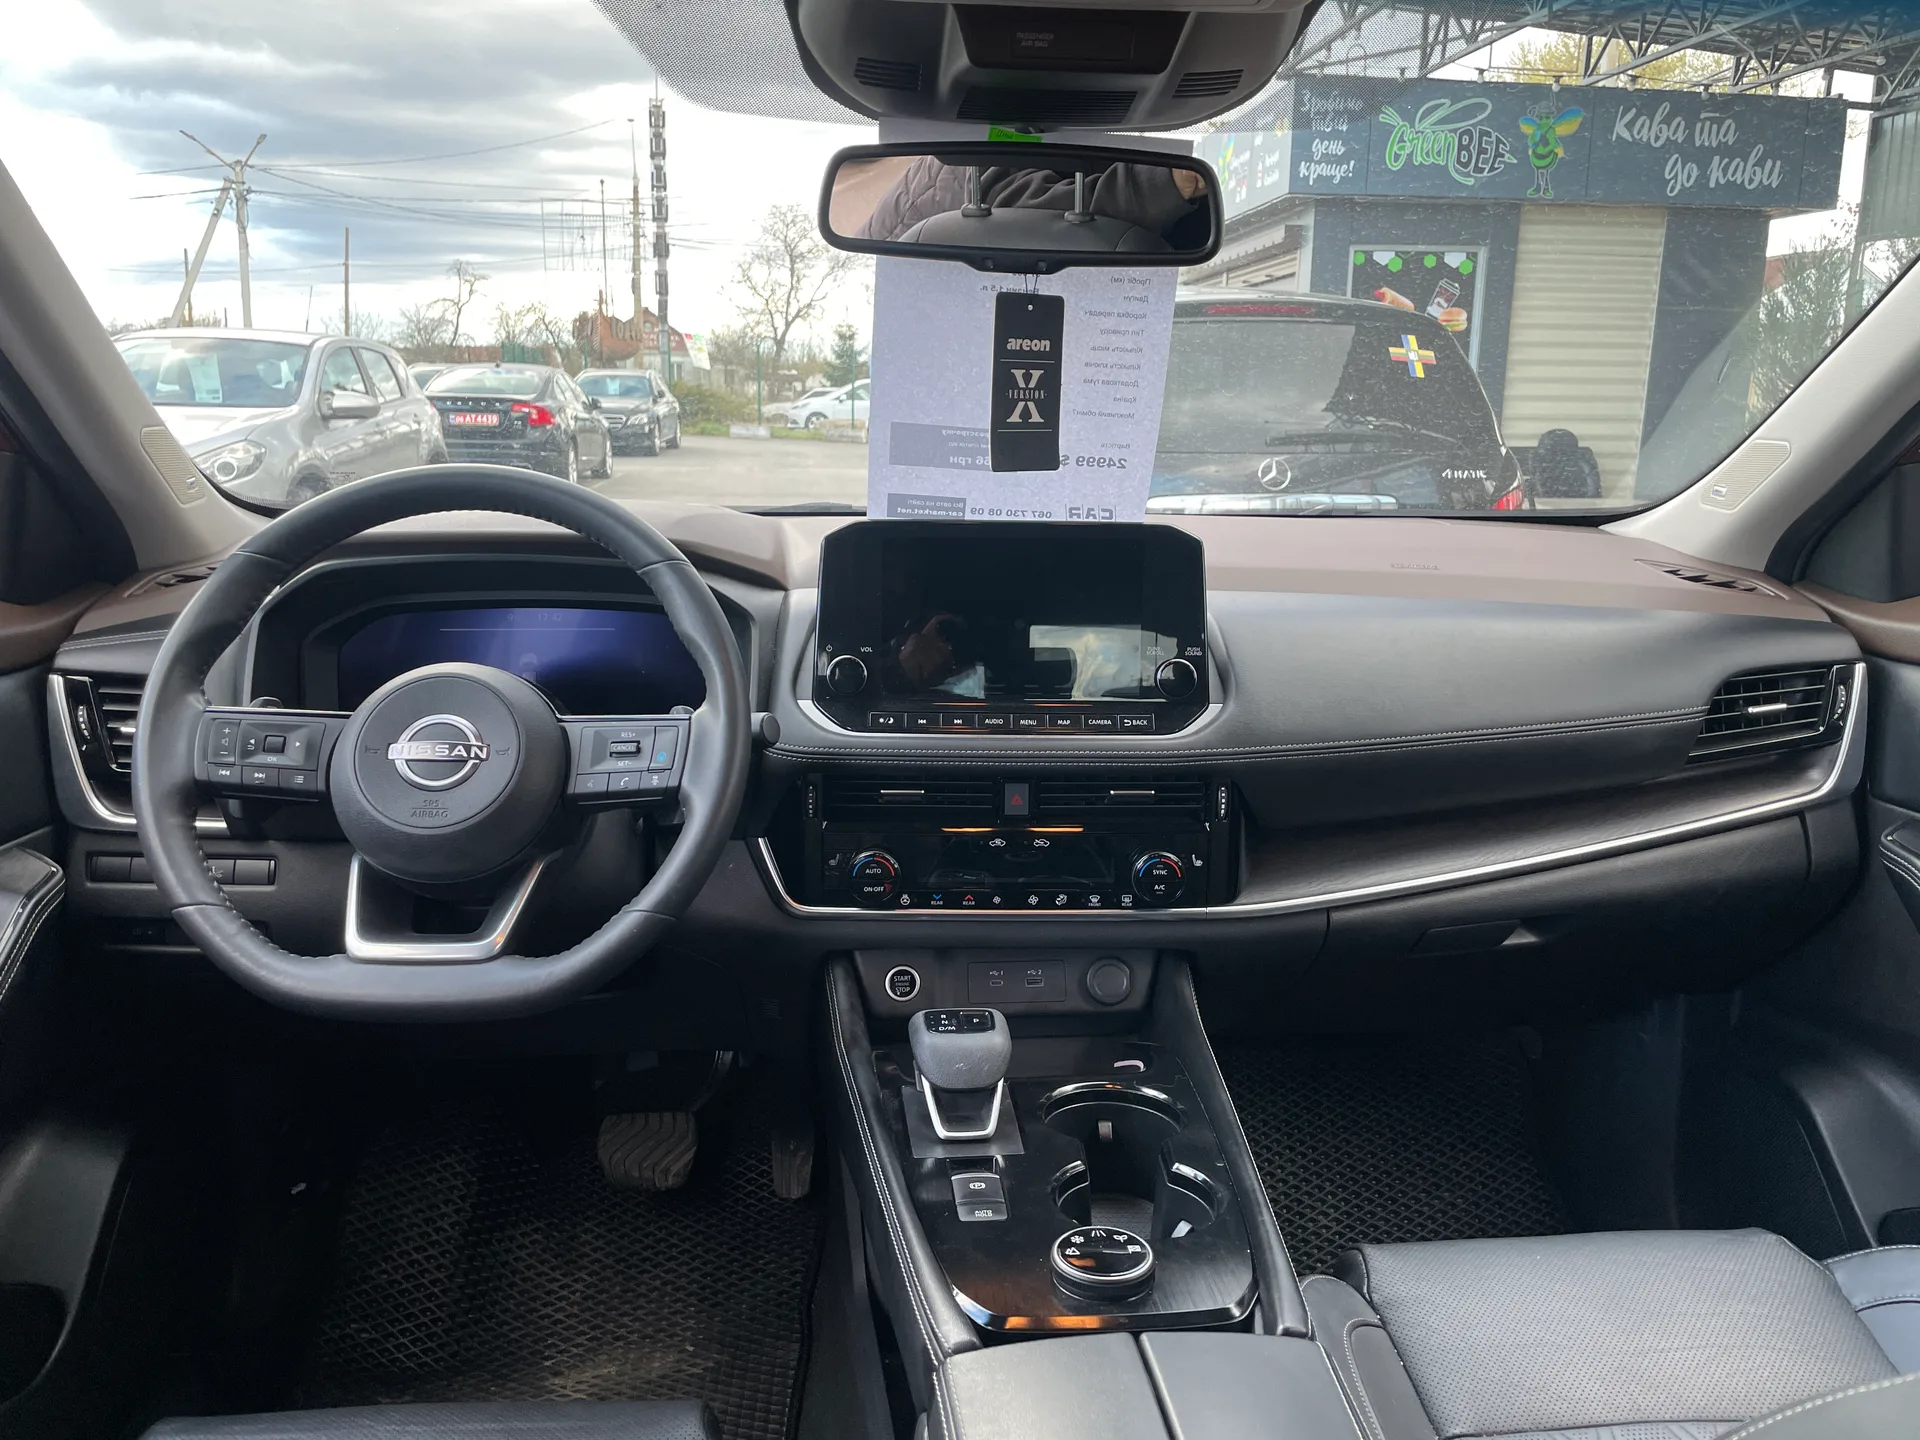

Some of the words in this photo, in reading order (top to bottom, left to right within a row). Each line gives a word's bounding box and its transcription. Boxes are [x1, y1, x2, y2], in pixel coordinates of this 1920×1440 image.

[1016, 31, 1055, 40] PASSENGER
[1612, 101, 1689, 148] Кава
[1694, 112, 1739, 148] та
[1312, 138, 1346, 161] день
[1299, 160, 1355, 186] краще!
[1664, 153, 1700, 197] до
[1706, 143, 1783, 190] кави
[1006, 337, 1051, 352] areon
[1008, 389, 1045, 399] VERSION
[391, 744, 488, 759] NISSAN
[612, 744, 636, 752] CANCEL
[422, 800, 440, 808] SRS
[410, 810, 449, 819] AIRBAG
